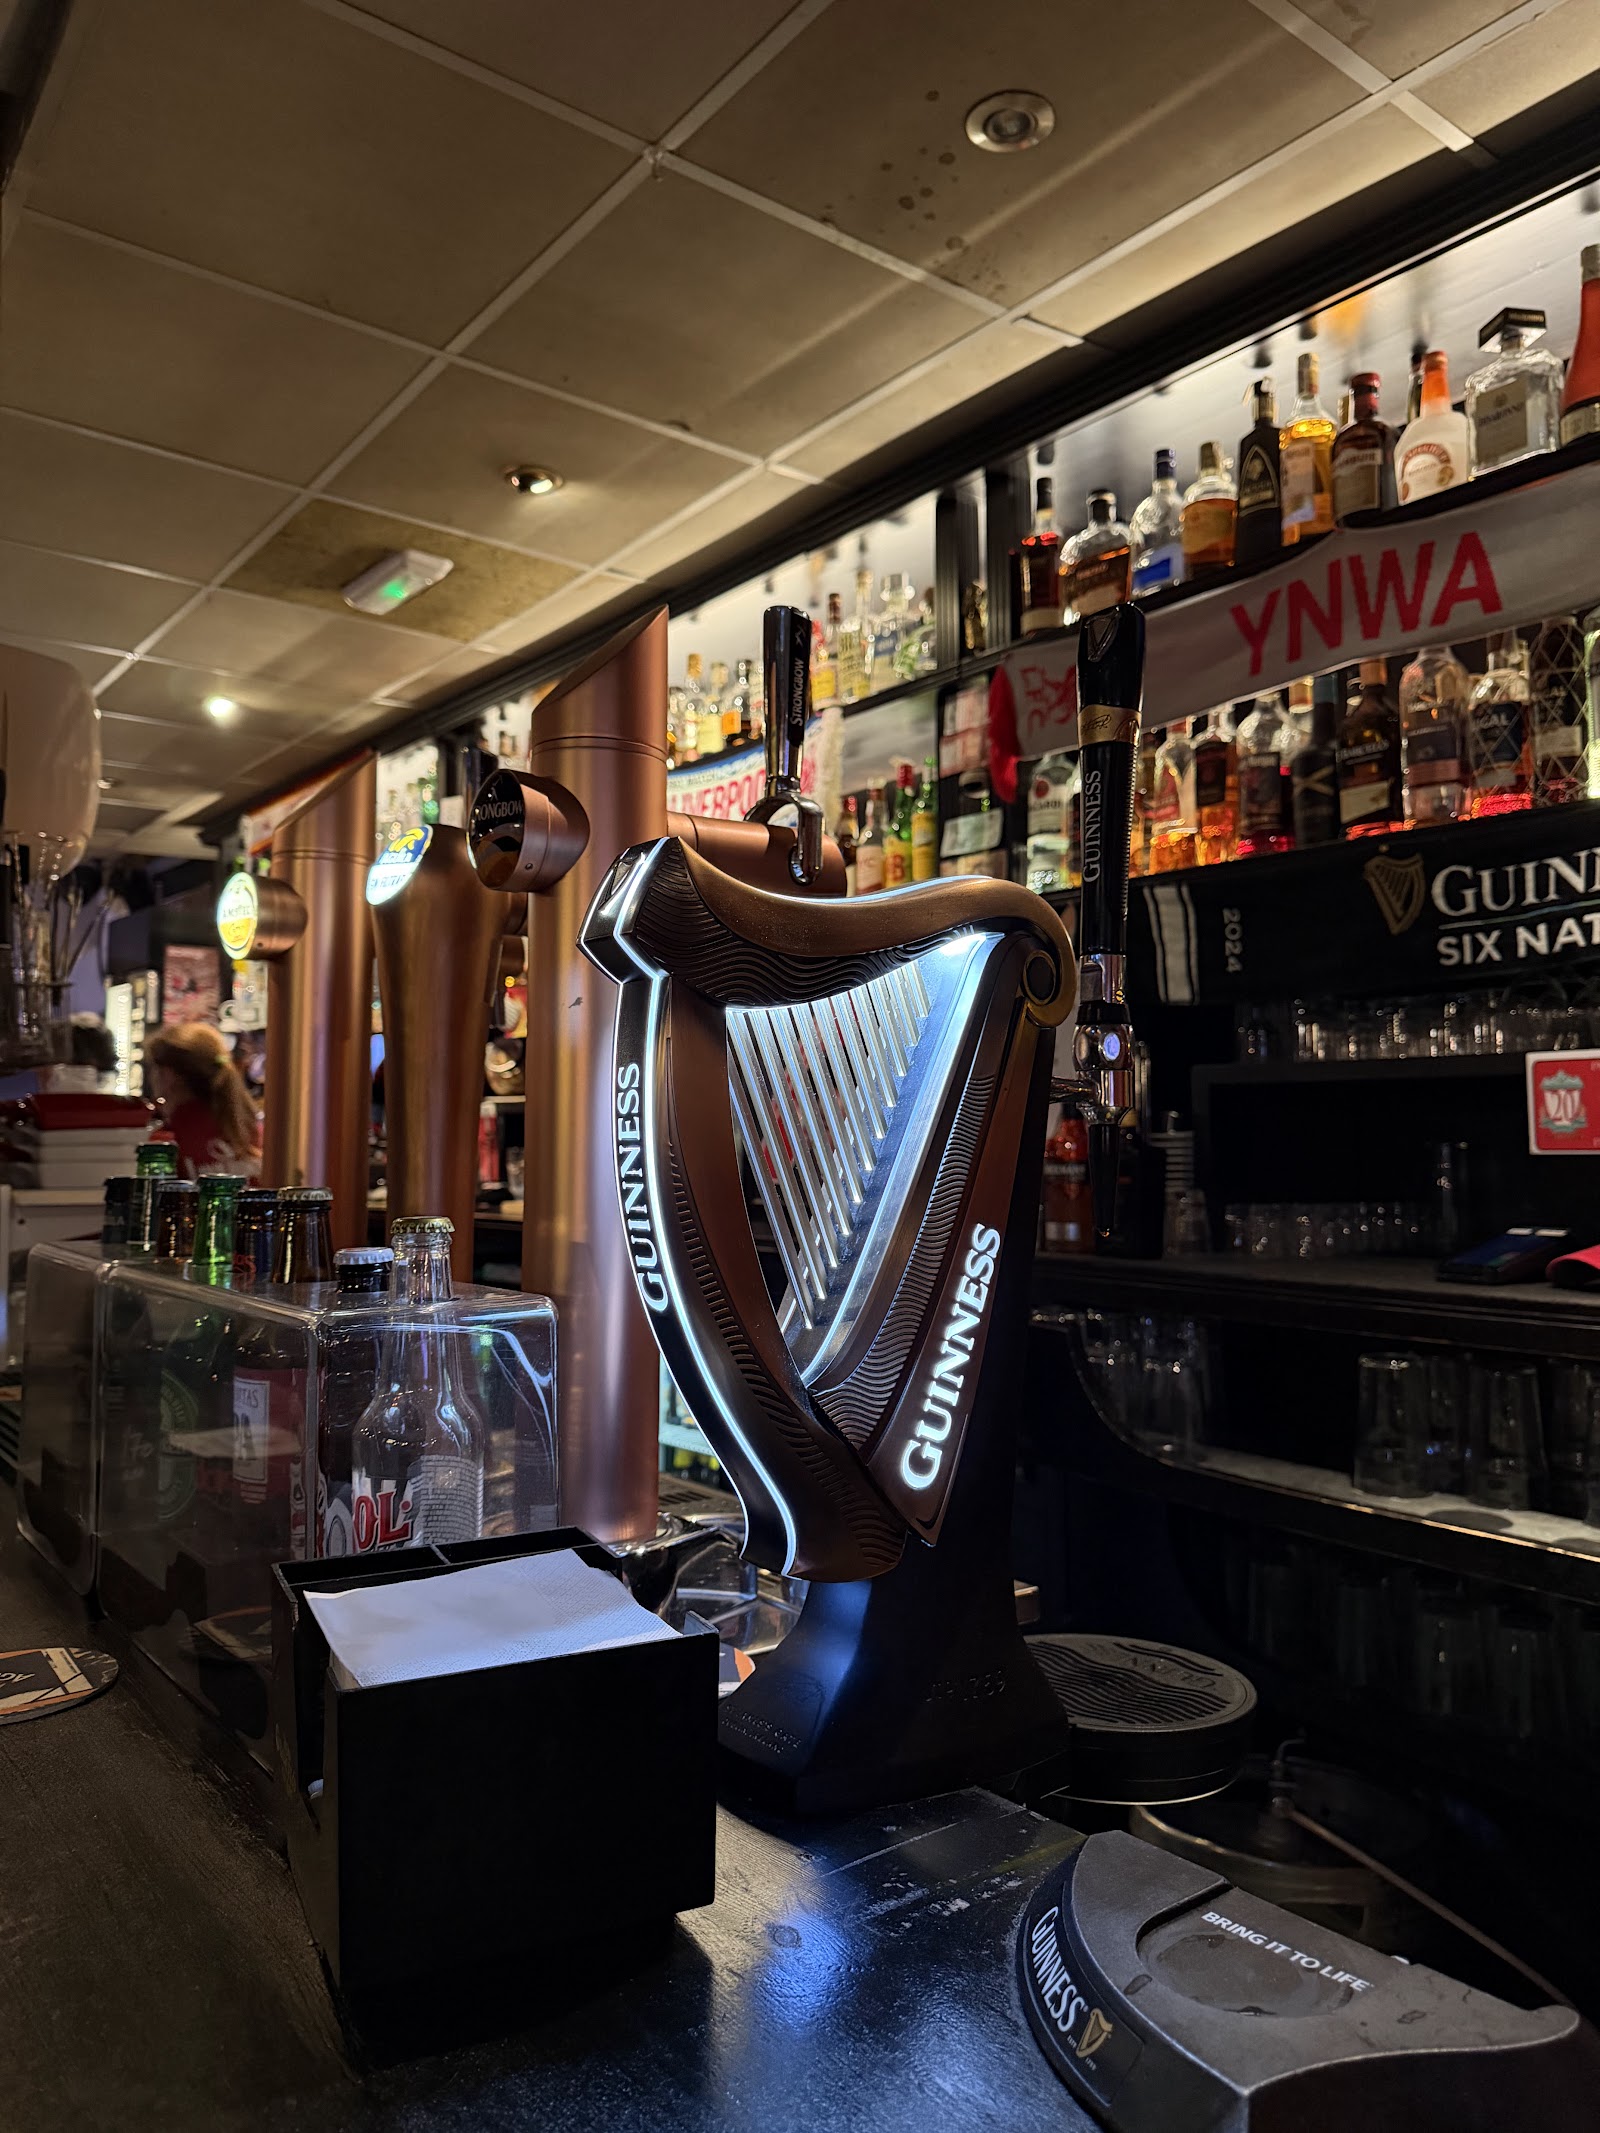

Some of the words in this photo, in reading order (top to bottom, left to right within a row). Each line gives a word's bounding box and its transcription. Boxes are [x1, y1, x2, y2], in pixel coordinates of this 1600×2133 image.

[1230, 531, 1503, 676] YNWA
[789, 659, 805, 727] STRONGBOW
[476, 799, 523, 821] RONGBOW
[1082, 770, 1101, 883] GUINNESS
[1222, 907, 1243, 973] 2024
[1436, 929, 1502, 966] SIX
[617, 1062, 668, 1313] GUINNESS
[901, 1223, 1001, 1490] GUINNESS
[353, 1489, 413, 1552] OL
[0, 1672, 36, 1683] AG
[1031, 1905, 1086, 2033] GUINNESS
[1200, 1911, 1268, 1945] BRING
[1264, 1940, 1291, 1954] IT
[1289, 1950, 1321, 1969] TO
[1319, 1965, 1370, 1992] LIFE
